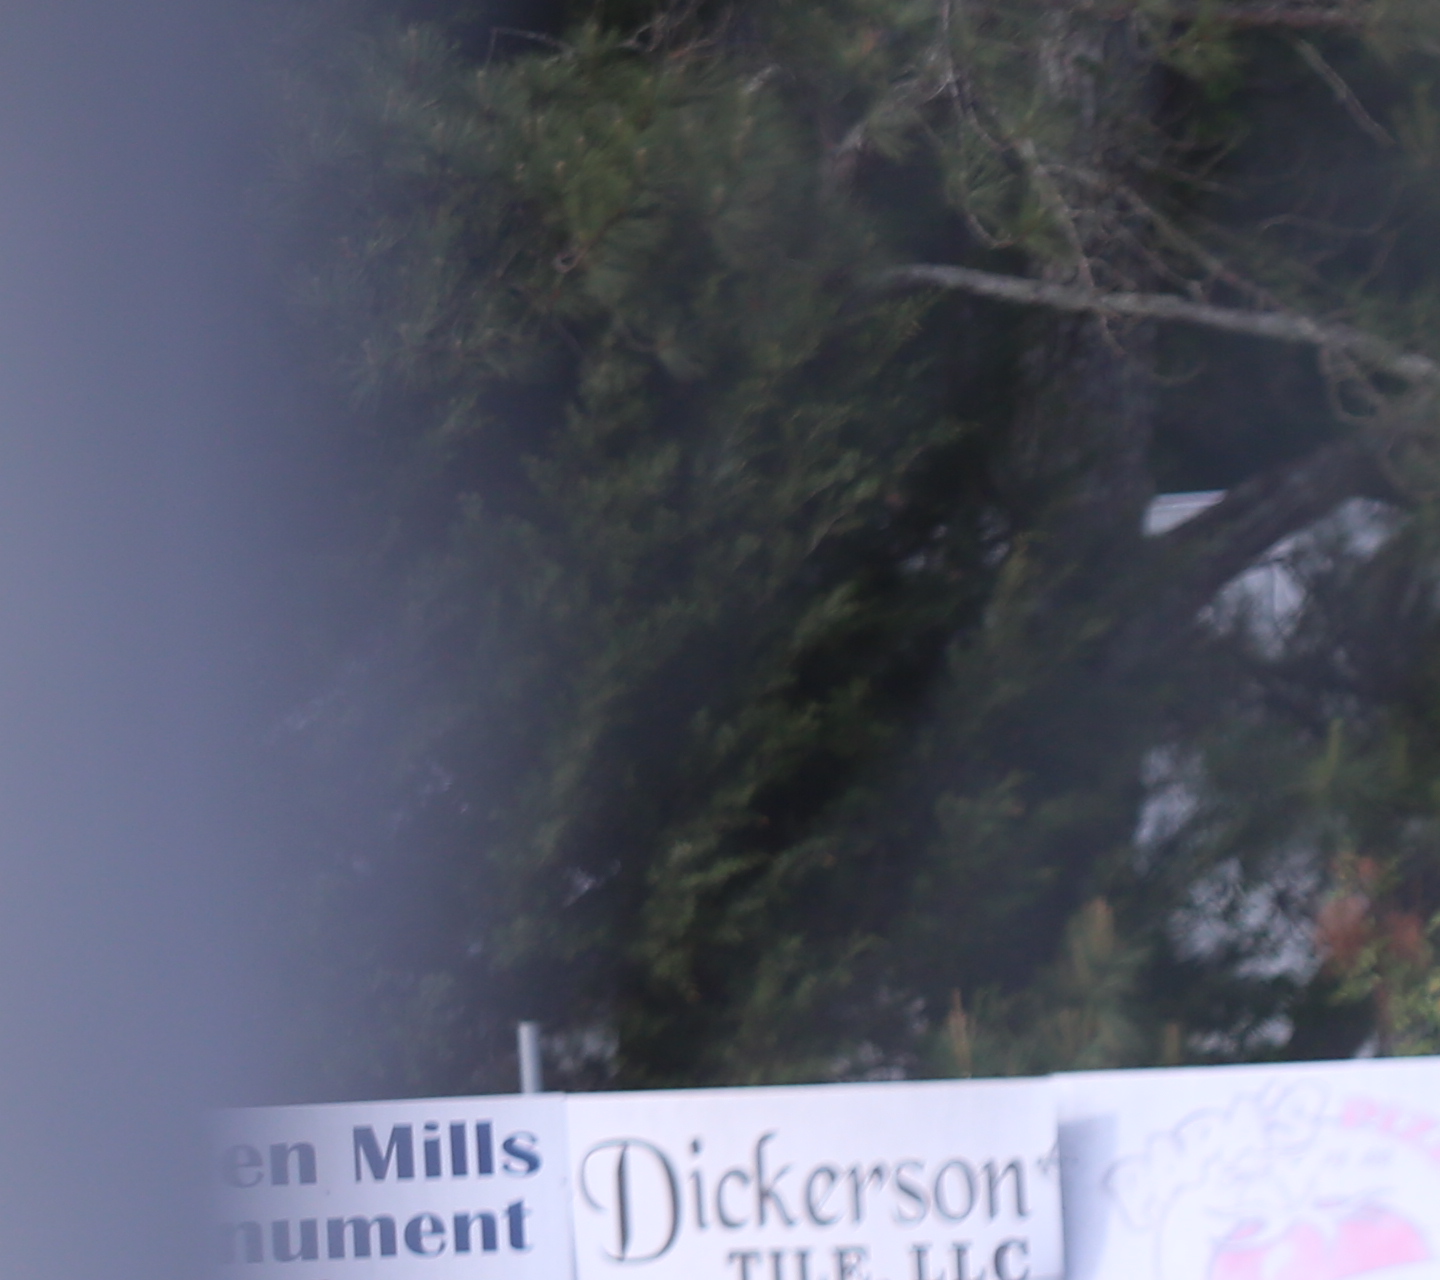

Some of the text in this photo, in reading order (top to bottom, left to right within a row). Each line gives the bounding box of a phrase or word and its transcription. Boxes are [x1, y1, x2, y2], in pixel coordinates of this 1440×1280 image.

[223, 1119, 542, 1188] en Mills
[581, 1131, 1030, 1264] Dickerson
